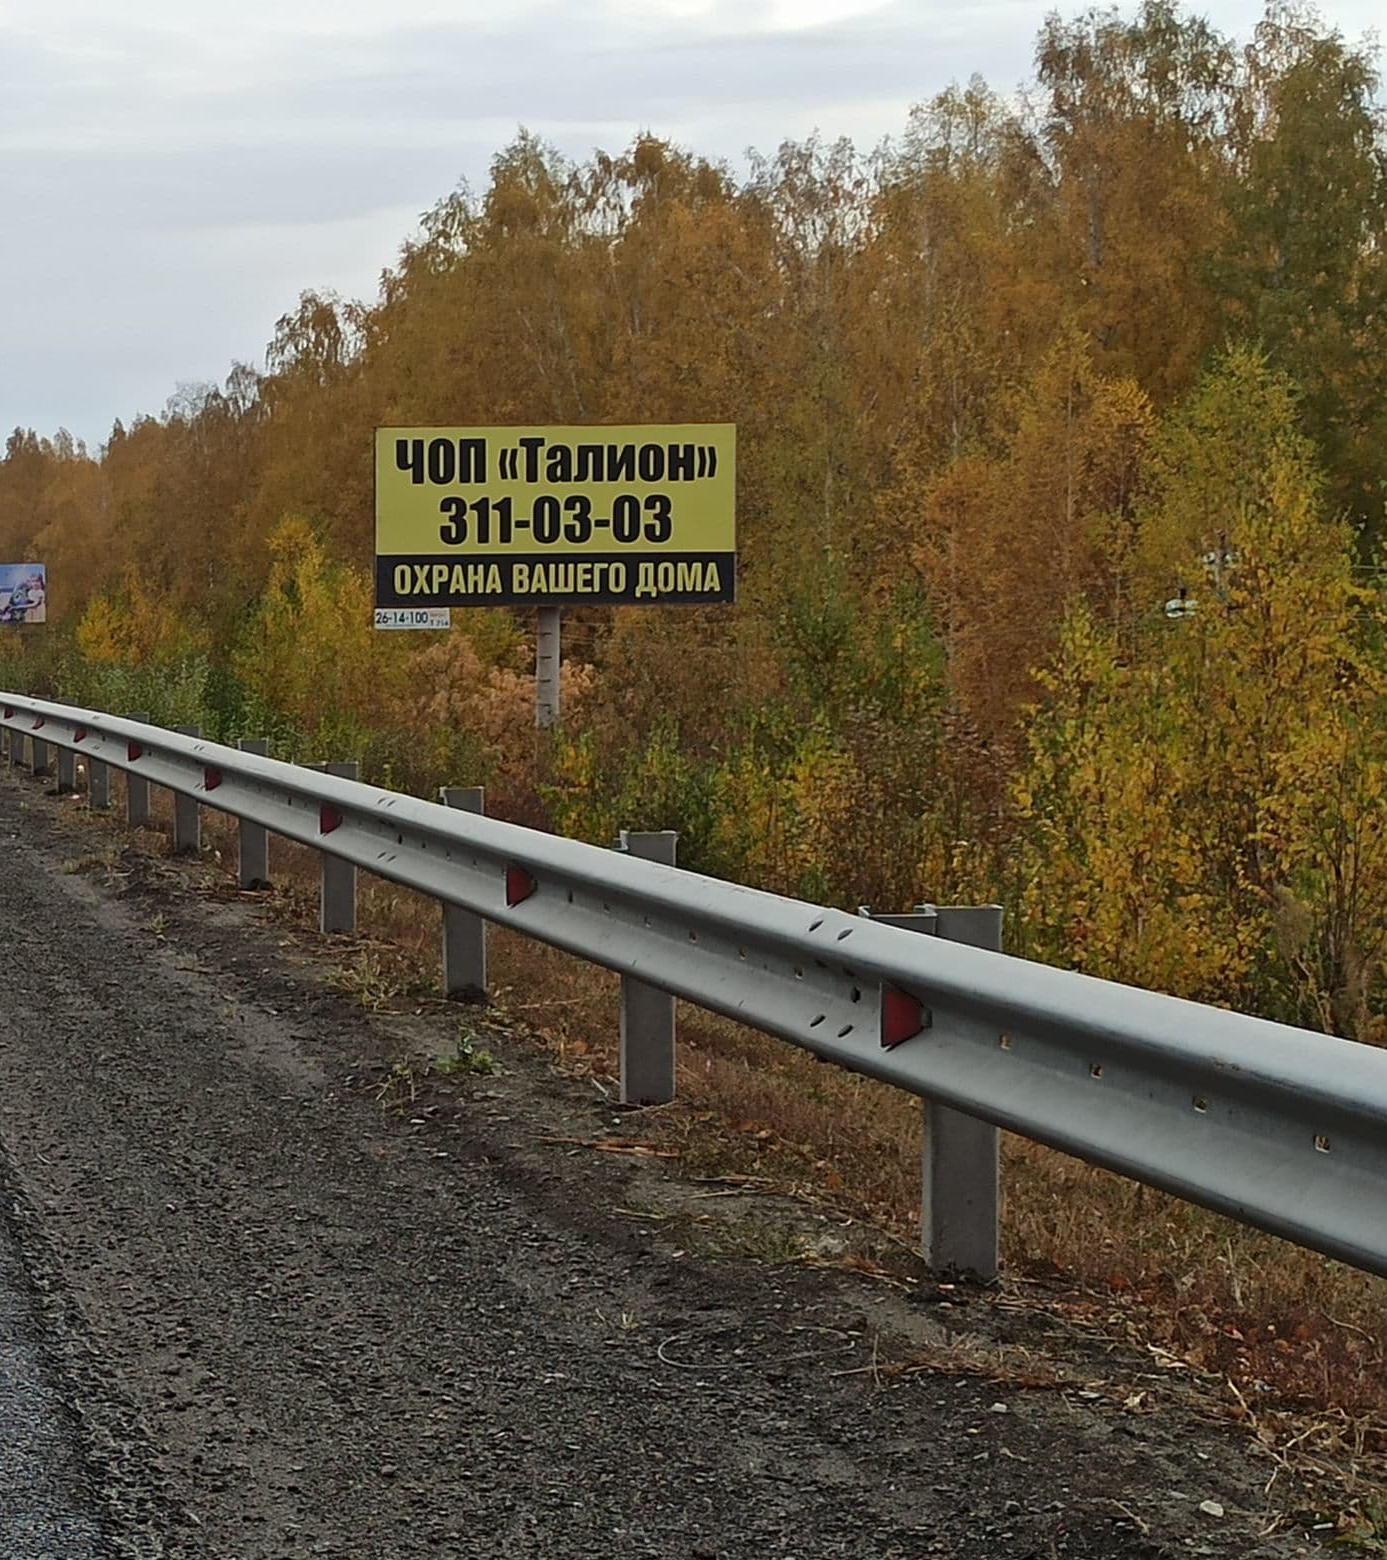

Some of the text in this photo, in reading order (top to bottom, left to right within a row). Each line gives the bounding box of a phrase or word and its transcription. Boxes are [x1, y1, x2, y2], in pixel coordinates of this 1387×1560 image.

[396, 437, 717, 484] ЧОП «Талион»
[440, 495, 672, 544] 311-03-03
[394, 562, 721, 599] ОХРАНА ВАШЕГО ДОМА
[375, 611, 429, 624] 26-14-100
